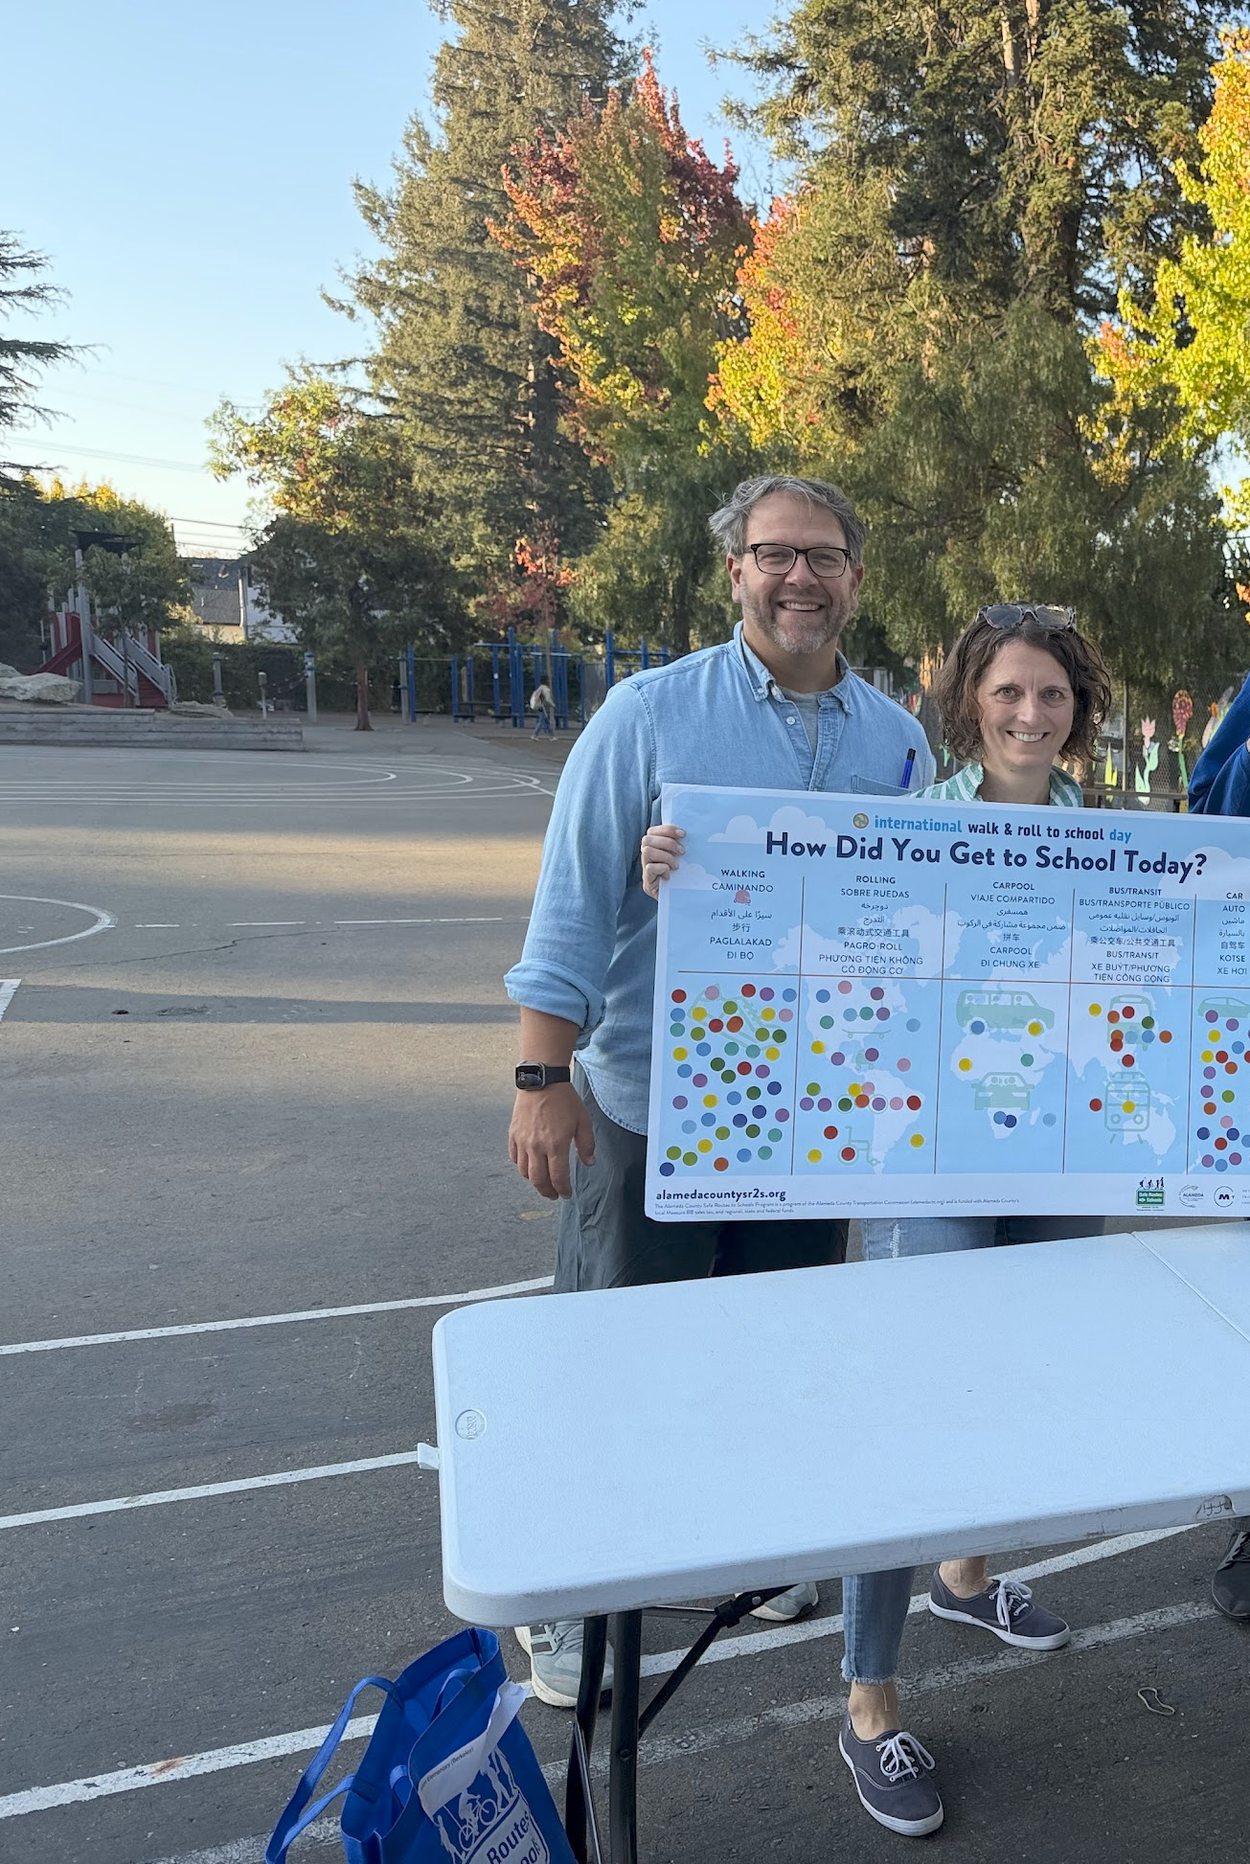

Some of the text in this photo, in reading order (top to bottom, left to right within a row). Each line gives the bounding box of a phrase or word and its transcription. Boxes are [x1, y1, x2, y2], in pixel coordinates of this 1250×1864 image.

[874, 815, 1132, 844] international walk & roll to school day
[766, 831, 1208, 884] How Did You Get to School Today?
[720, 869, 766, 879] WALKING
[856, 875, 896, 884] ROLLING
[711, 882, 774, 893] CAMINANDO
[992, 881, 1035, 891] CARPOOL
[1109, 886, 1162, 896] BUS/TRANSIT
[841, 888, 910, 899] SOBRE RUEDAS
[1226, 892, 1244, 900] CAR
[970, 894, 1055, 905] VIAJE COMPARTIDO
[1079, 898, 1190, 910] BUS/TRANSPORTE PÚBLICO
[1222, 905, 1246, 913] AUTO
[709, 936, 772, 946] PAGLALAKAD
[727, 951, 737, 959] ĐI
[989, 946, 1033, 955] CARPOOL
[1106, 950, 1159, 960] BUS/TRANSIT
[1219, 954, 1246, 963] KOTSE
[981, 959, 1040, 969] ĐI CHUNG XE
[1091, 963, 1103, 971] XE
[1217, 967, 1229, 975] XE
[656, 1188, 787, 1202] alamedacountysr2s.org
